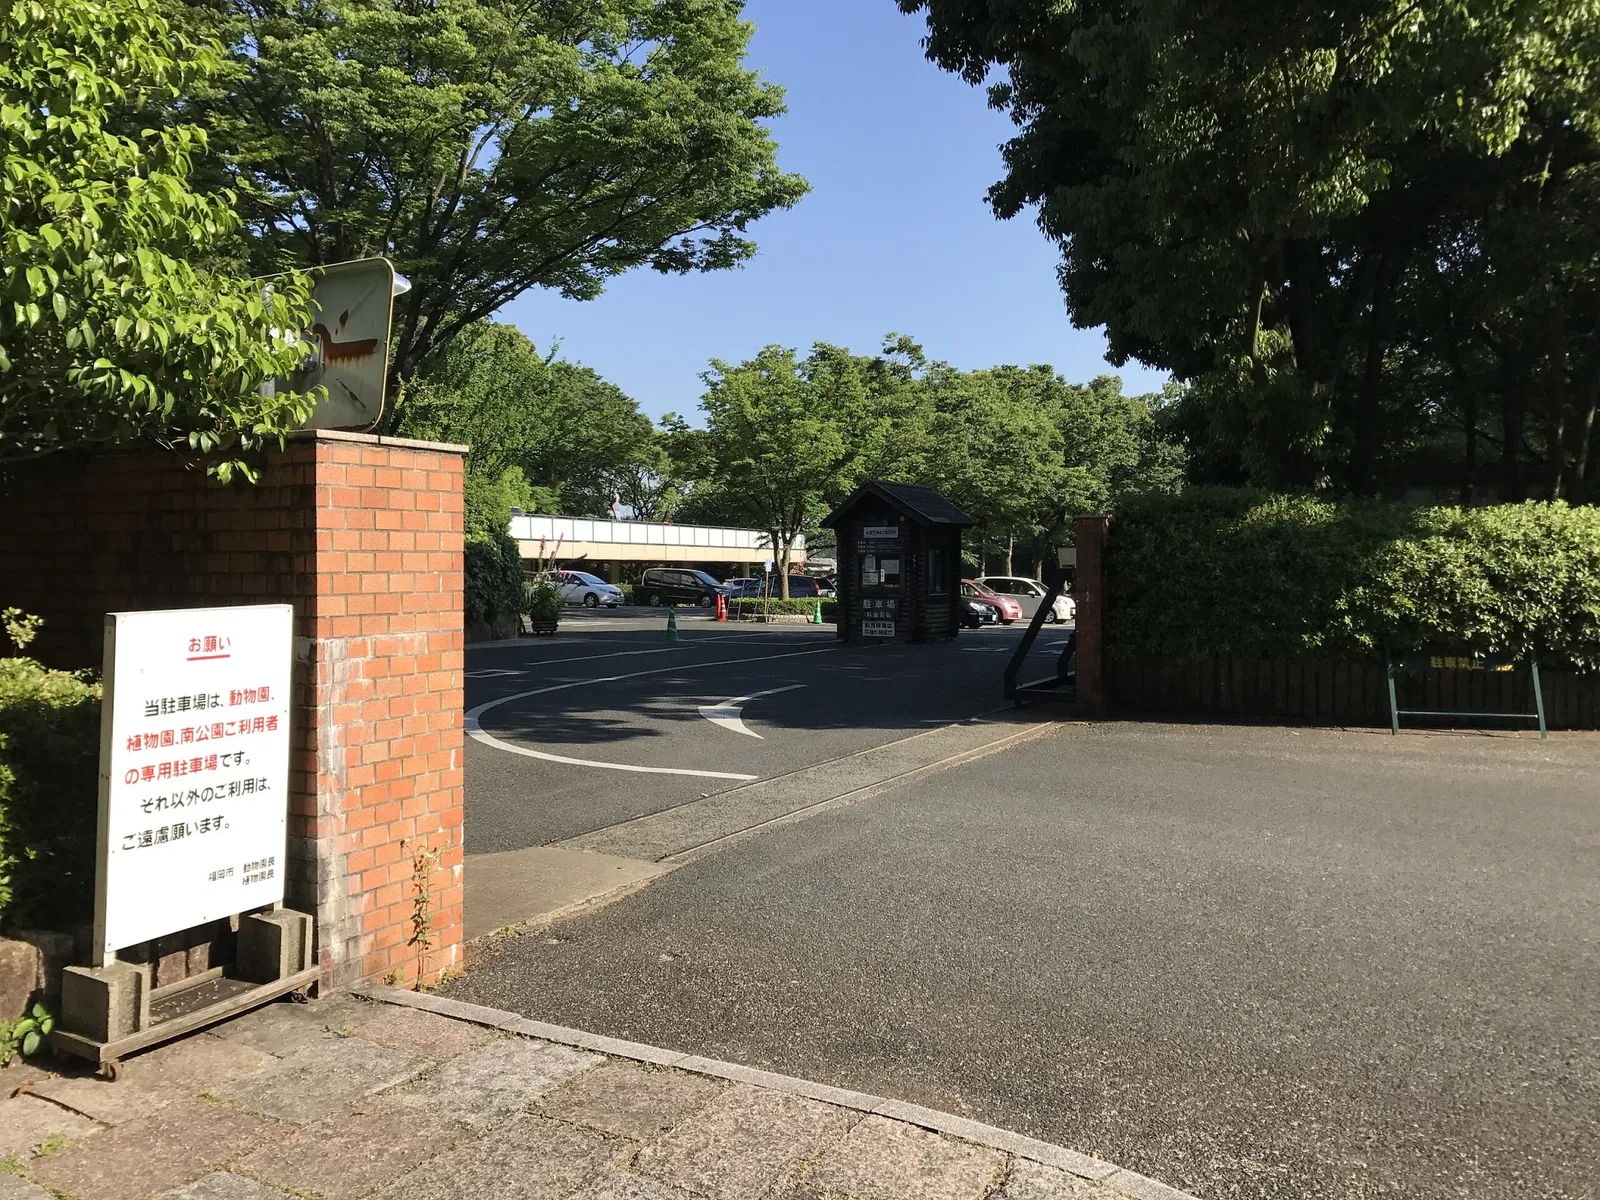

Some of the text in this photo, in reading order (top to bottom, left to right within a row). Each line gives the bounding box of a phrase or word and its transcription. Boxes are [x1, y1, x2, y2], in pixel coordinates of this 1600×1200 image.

[188, 635, 231, 653] お願い
[144, 686, 275, 717] 当駐車場は、動物園、
[126, 714, 279, 752] 植物園、南公園ご利用者
[124, 750, 251, 785] の専用駐車場です。
[139, 776, 271, 814] それ以外のご利用は、
[121, 814, 230, 851] ご遠慮願います。
[208, 856, 275, 883] 福岡市 動物園長
